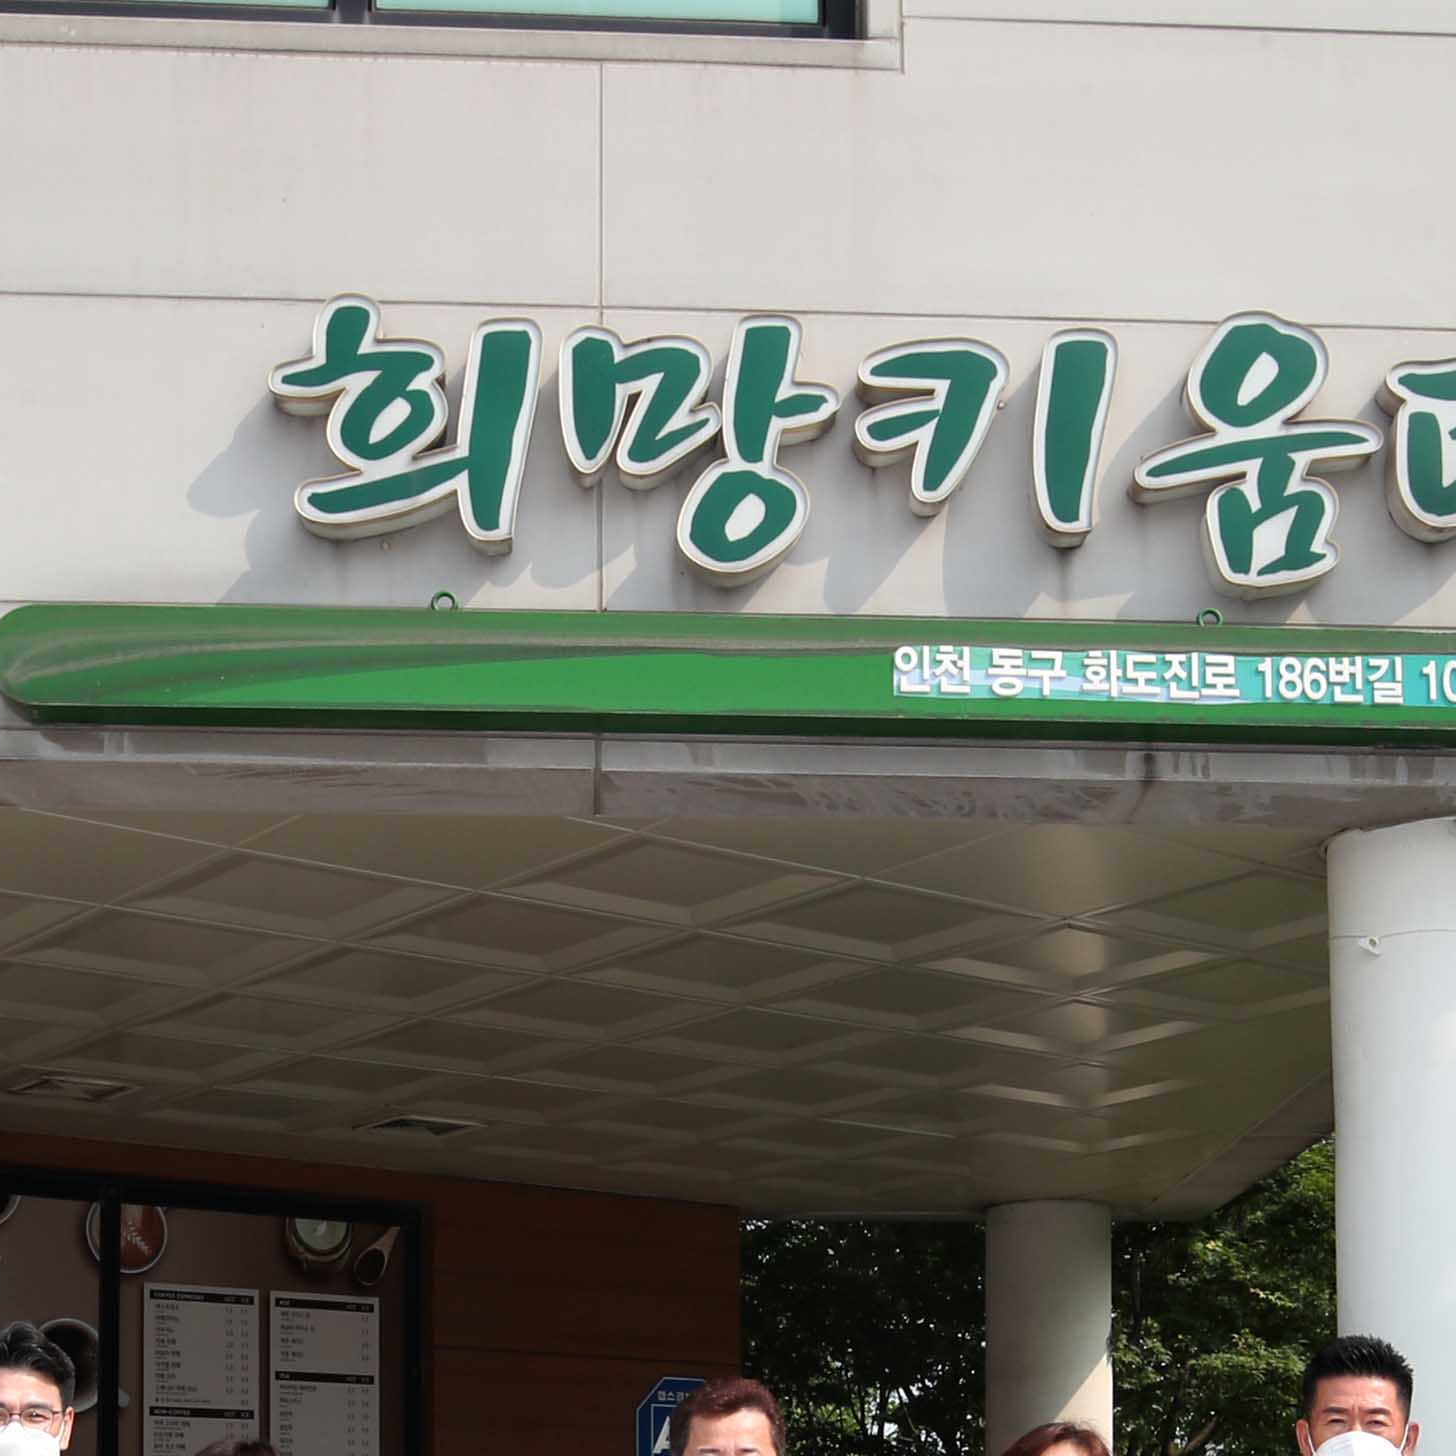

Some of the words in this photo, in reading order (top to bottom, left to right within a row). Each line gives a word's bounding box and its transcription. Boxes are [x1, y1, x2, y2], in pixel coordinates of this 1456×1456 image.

[894, 645, 971, 695] 인천
[986, 650, 1068, 697] 동구
[1082, 651, 1240, 700] 화도진로
[1258, 656, 1404, 706] 186번길
